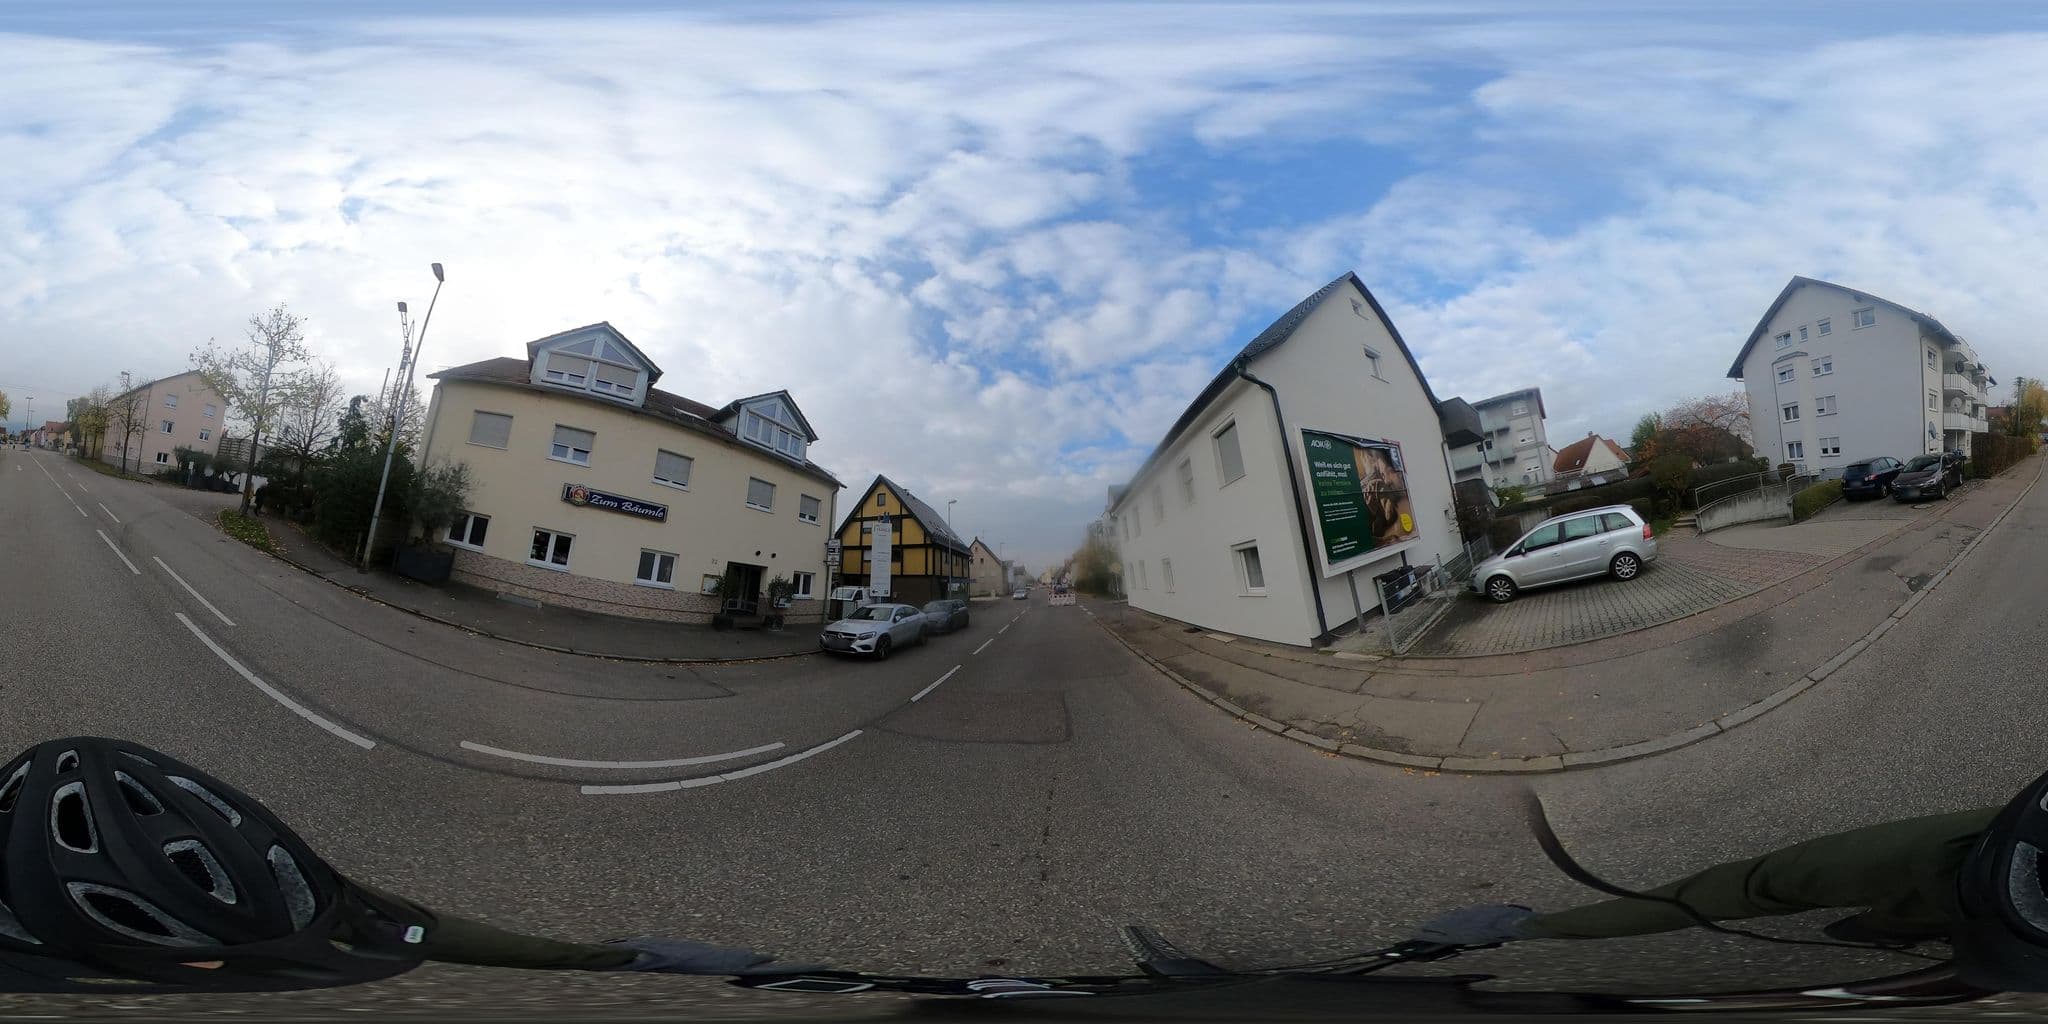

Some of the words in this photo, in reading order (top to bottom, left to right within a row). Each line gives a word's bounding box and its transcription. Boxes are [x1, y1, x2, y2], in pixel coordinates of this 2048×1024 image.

[1311, 440, 1325, 448] AOK
[590, 494, 618, 508] Zum
[621, 501, 664, 518] Bäumle
